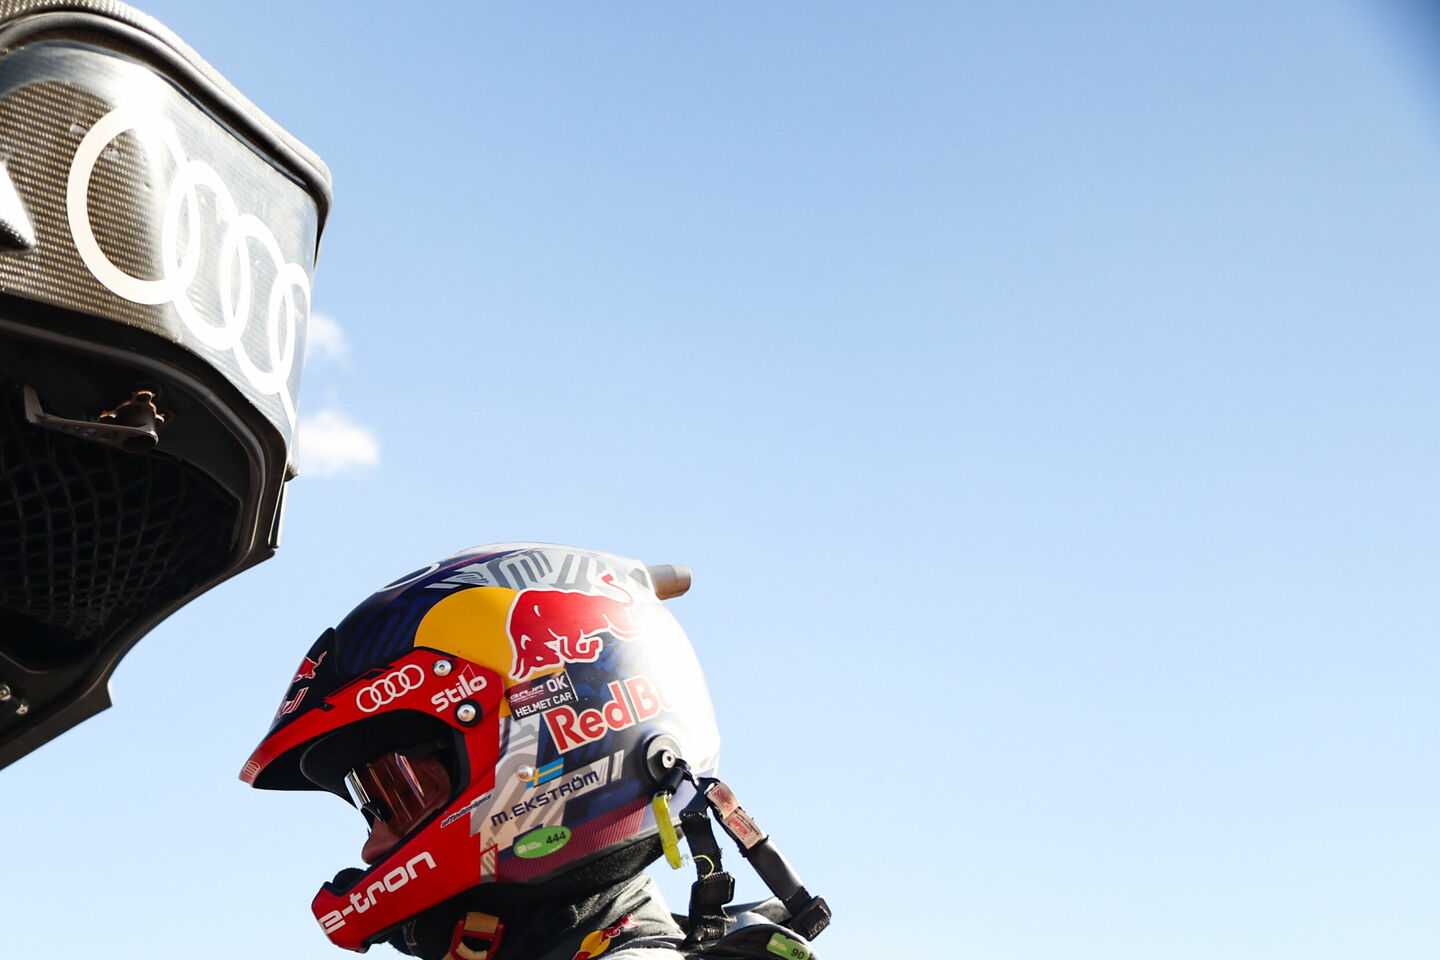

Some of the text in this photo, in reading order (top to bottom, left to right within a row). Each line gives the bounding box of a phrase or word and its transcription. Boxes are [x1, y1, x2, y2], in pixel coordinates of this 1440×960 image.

[431, 674, 488, 713] Stilo
[545, 675, 569, 692] OK
[515, 699, 552, 718] HELMET
[552, 692, 573, 705] CAR
[543, 680, 636, 754] Red
[546, 830, 567, 844] 444
[318, 851, 437, 935] e-tron
[790, 948, 805, 960] 90
